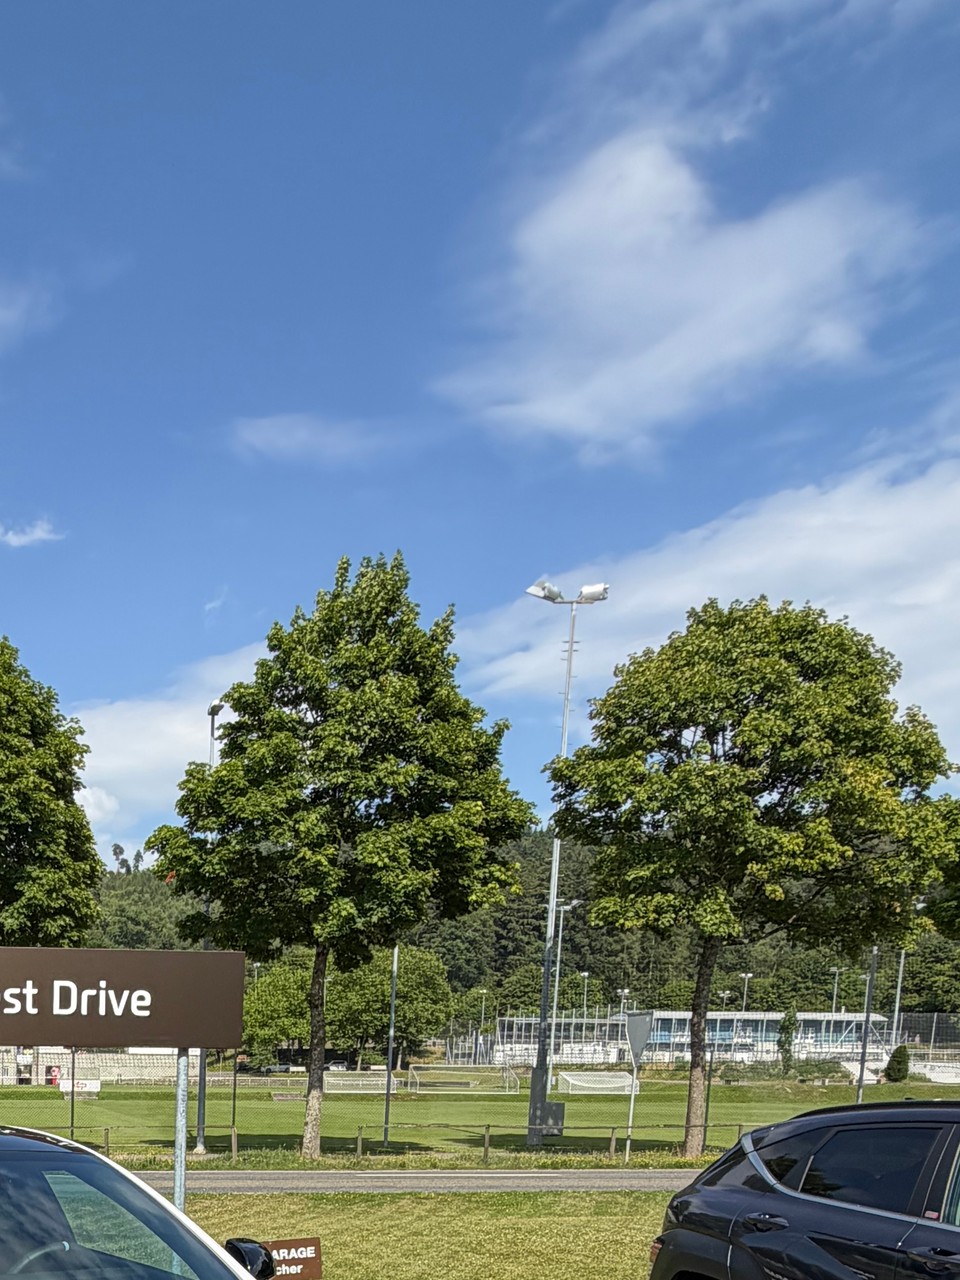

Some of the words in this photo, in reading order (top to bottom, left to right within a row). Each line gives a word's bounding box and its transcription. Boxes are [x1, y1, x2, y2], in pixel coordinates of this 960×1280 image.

[53, 980, 152, 1017] Drive
[272, 1246, 316, 1260] ARAGE
[276, 1264, 303, 1276] cher
